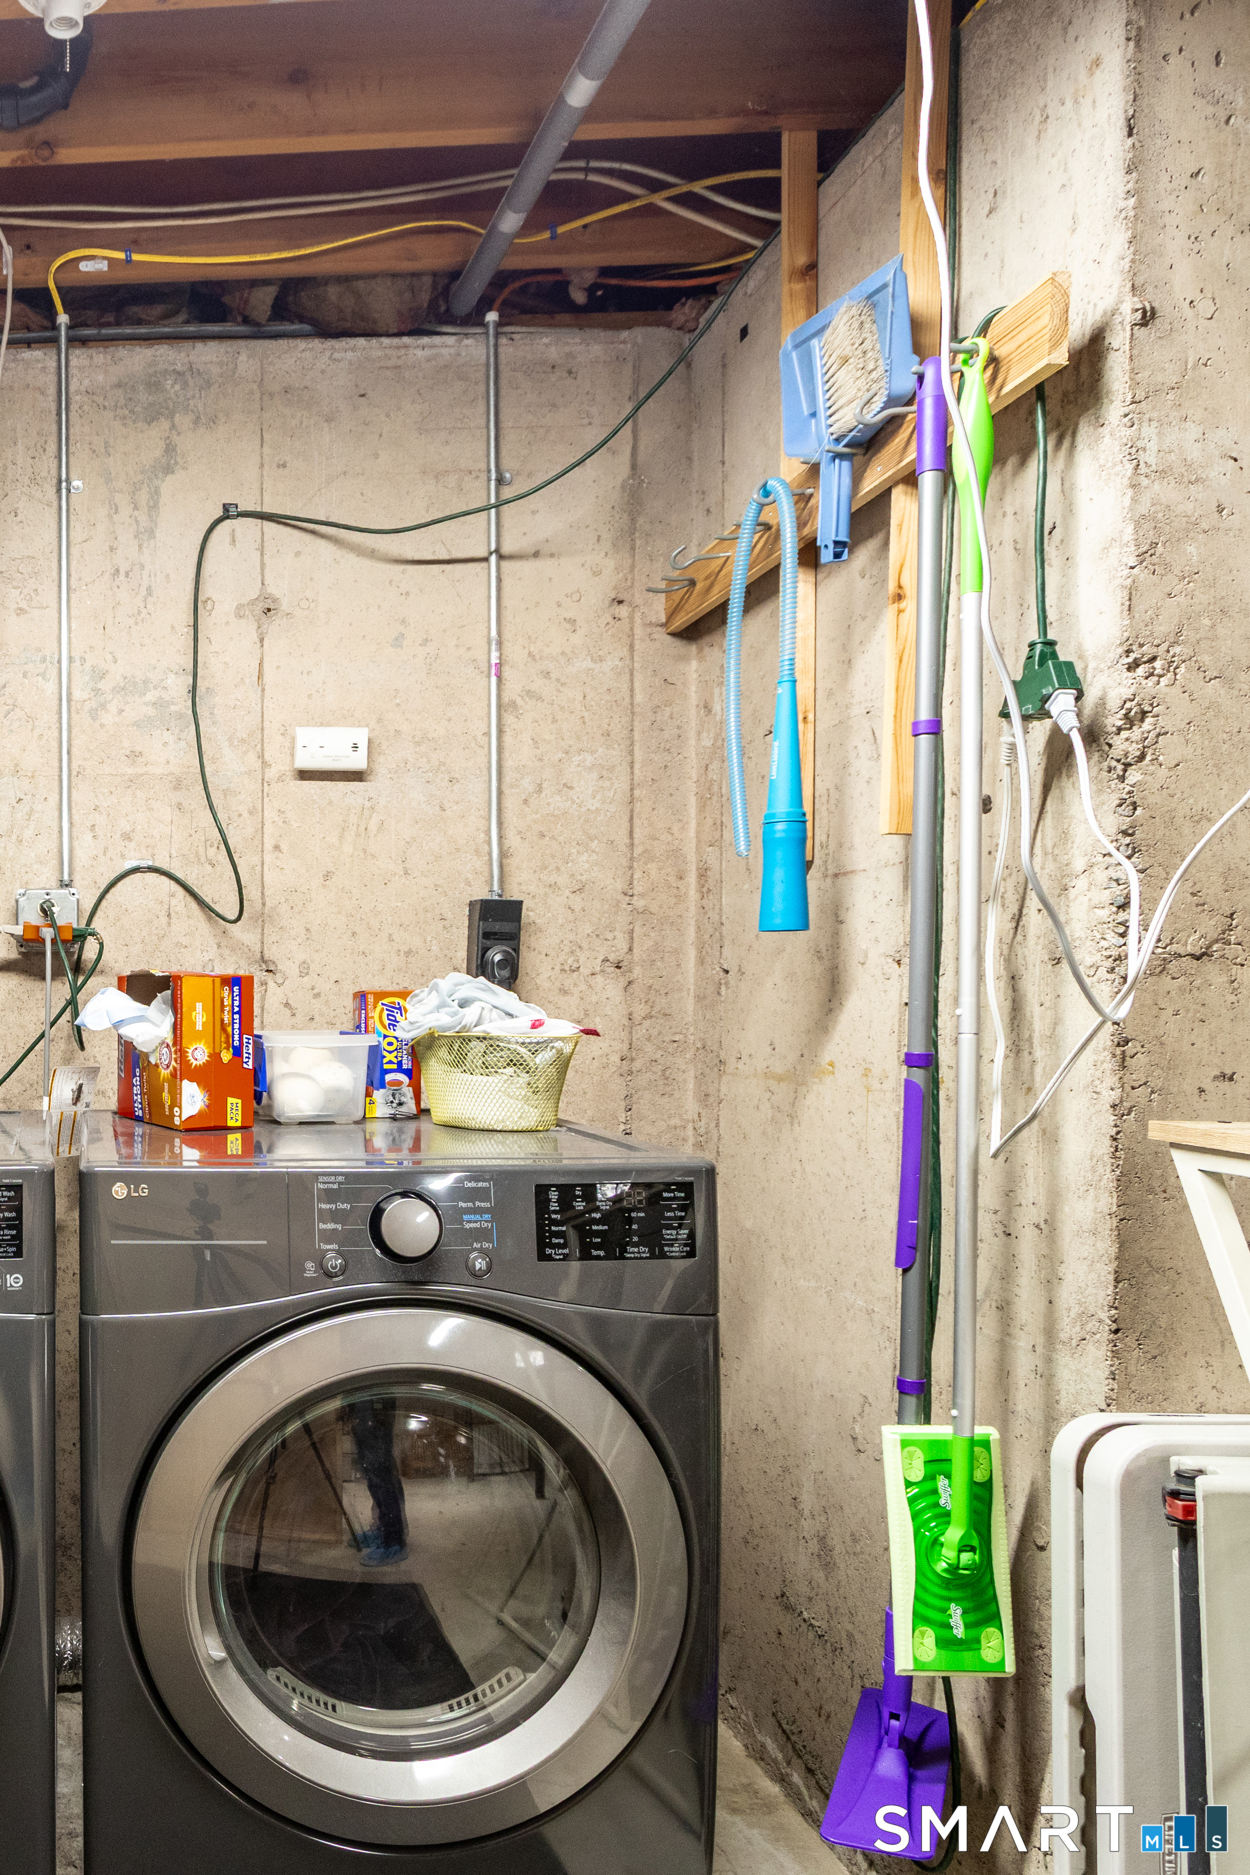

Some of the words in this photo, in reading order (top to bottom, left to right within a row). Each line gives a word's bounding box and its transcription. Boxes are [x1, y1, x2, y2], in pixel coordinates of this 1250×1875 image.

[380, 1001, 404, 1032] Tide
[244, 1035, 252, 1068] Hefty
[383, 1037, 397, 1069] OXI
[130, 1184, 148, 1196] LG
[939, 1475, 952, 1510] Swiffer
[950, 1603, 963, 1639] Swiffer
